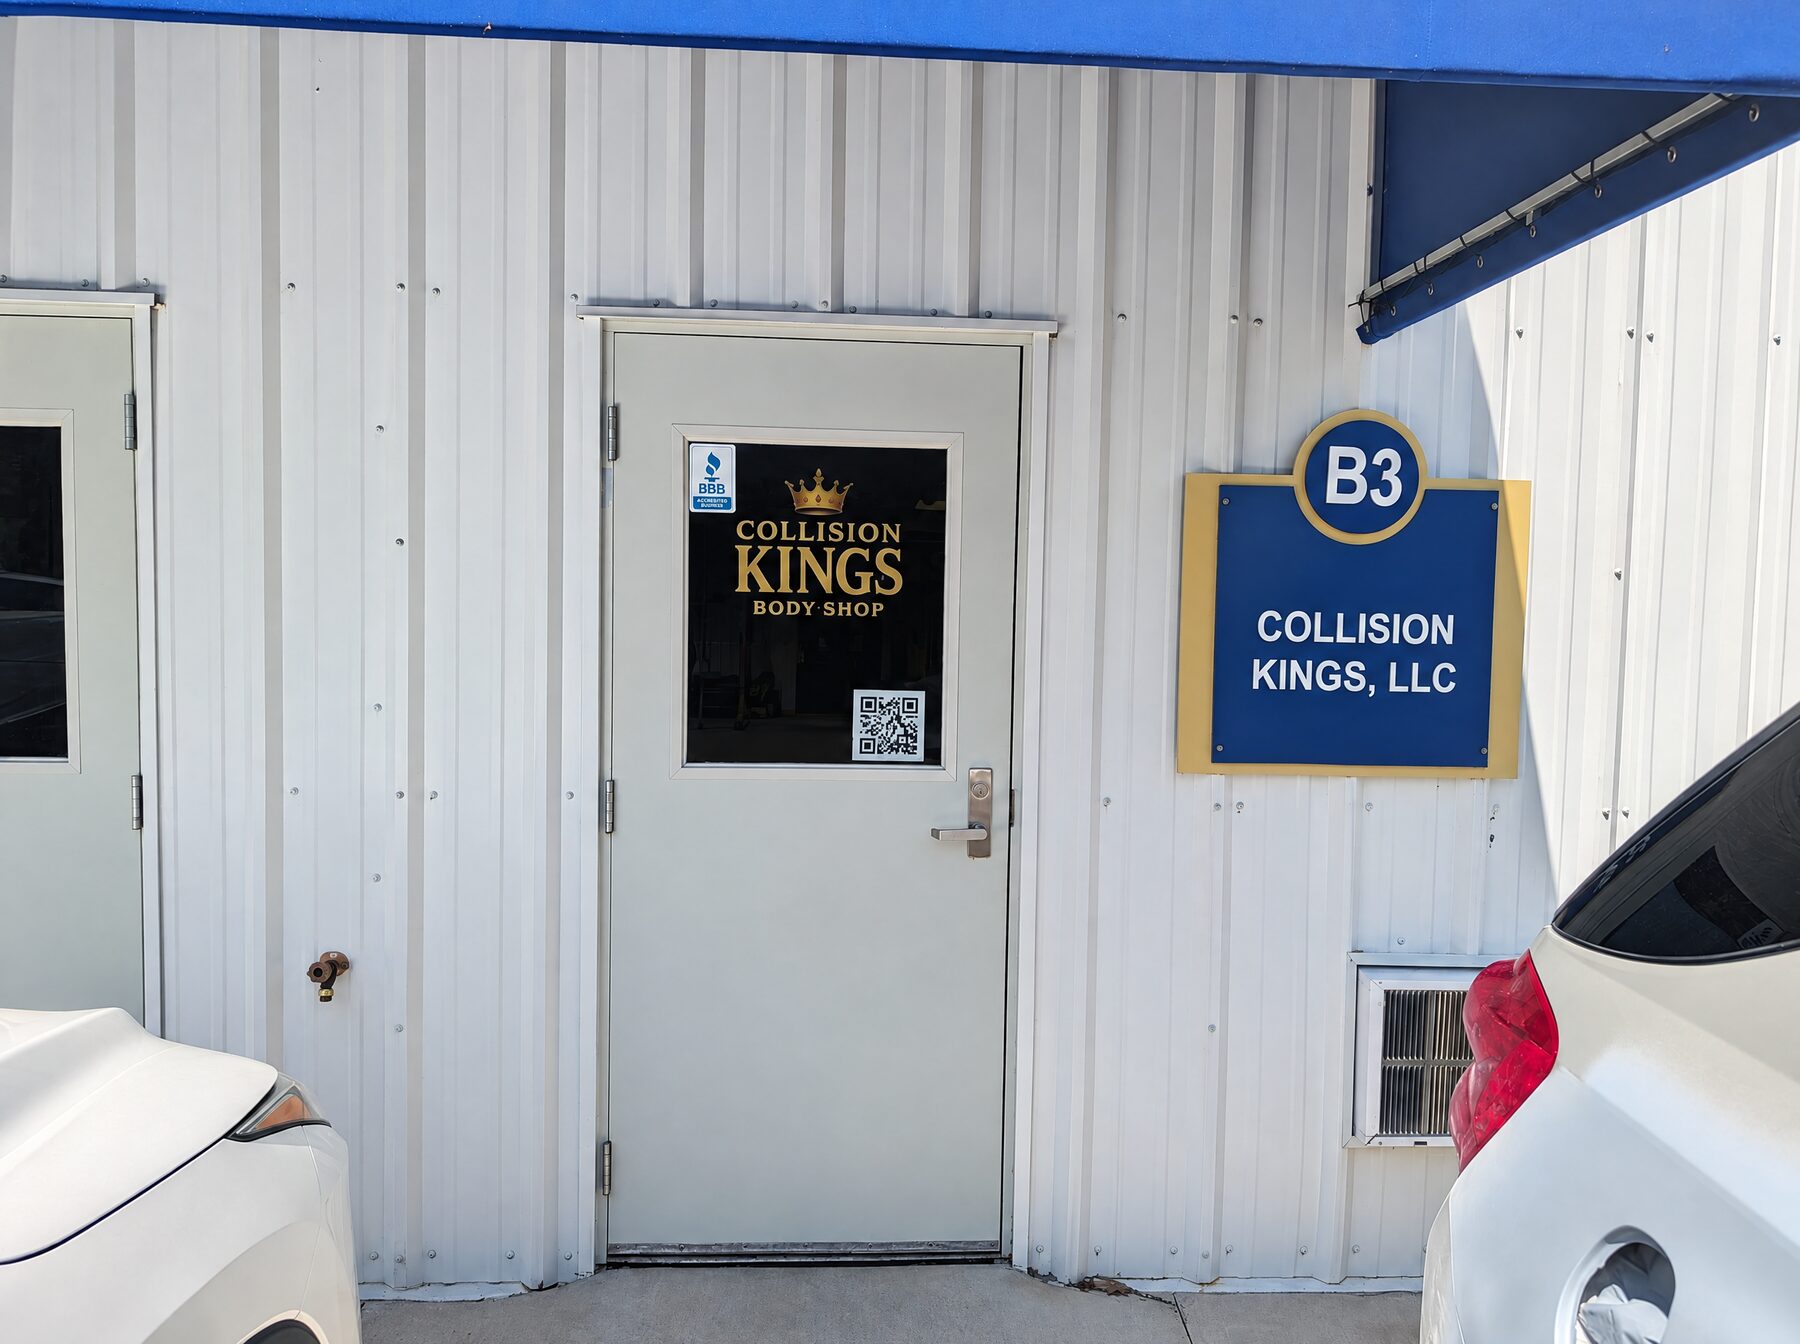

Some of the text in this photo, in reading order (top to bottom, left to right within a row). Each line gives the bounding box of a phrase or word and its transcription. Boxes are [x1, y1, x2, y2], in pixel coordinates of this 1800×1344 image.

[698, 482, 726, 495] BBB
[1325, 445, 1403, 507] B3
[736, 519, 902, 543] COLLISION
[734, 544, 903, 596] KINGS
[752, 600, 884, 617] BODY SHOP
[1257, 609, 1455, 645] COLLISION
[1252, 658, 1456, 697] KINGS, LLC
